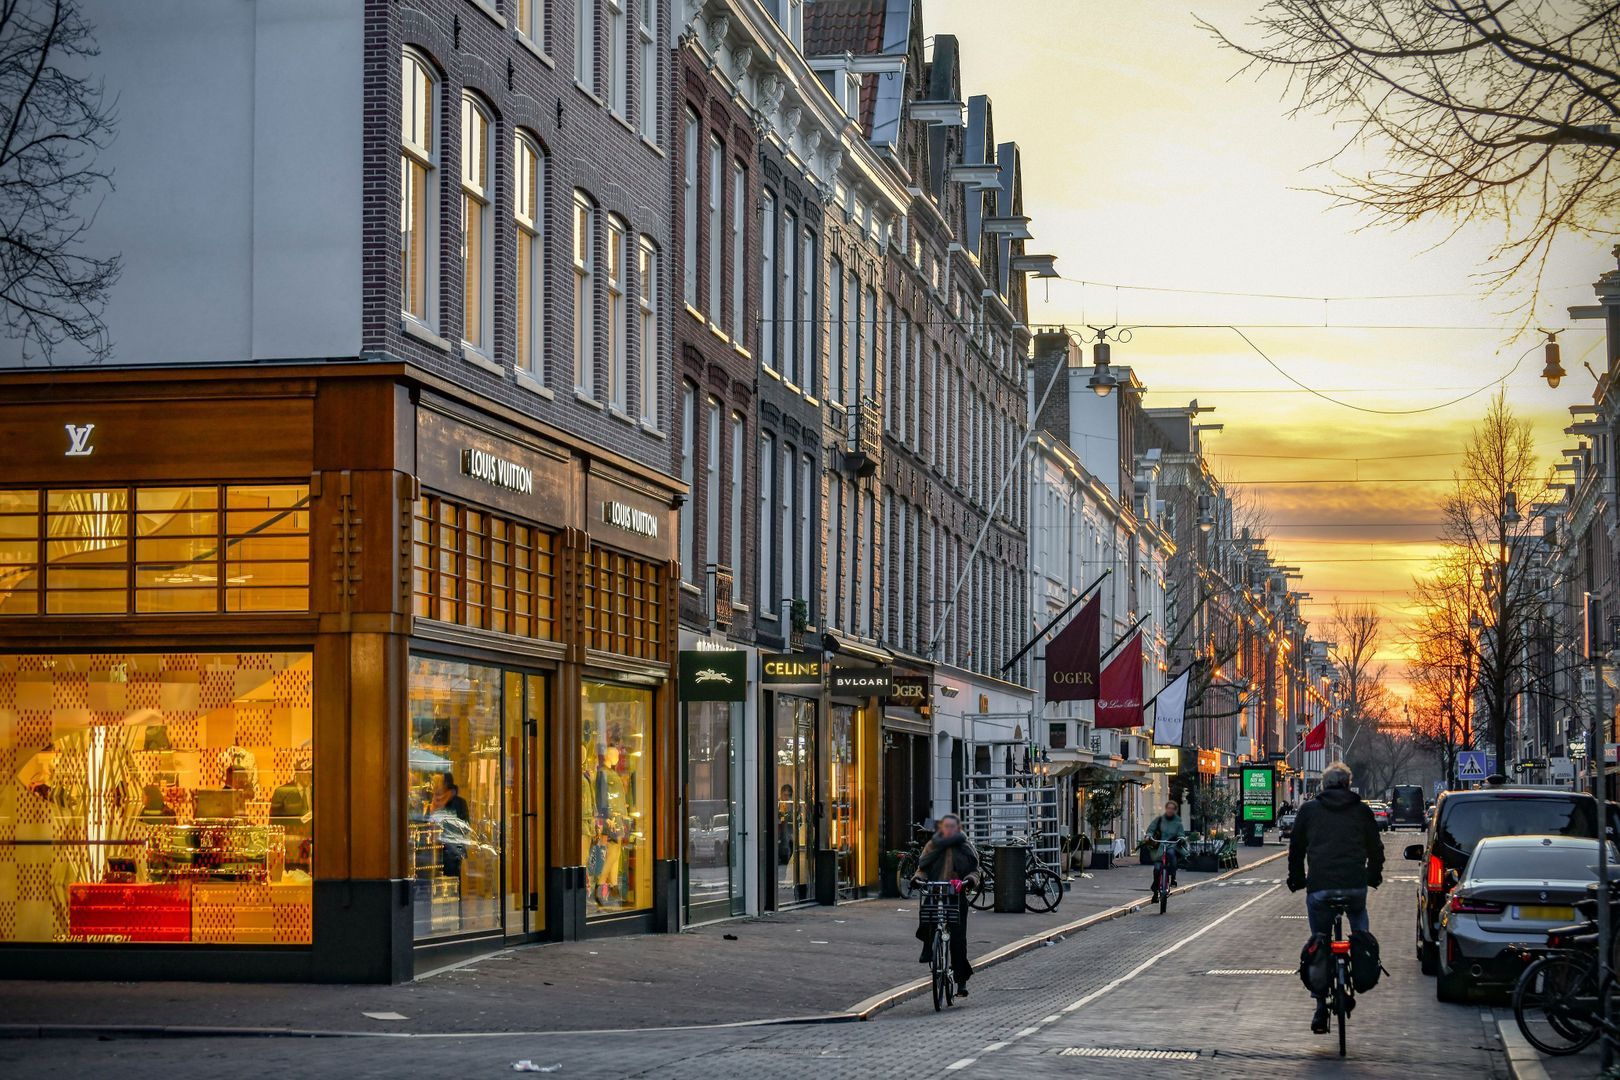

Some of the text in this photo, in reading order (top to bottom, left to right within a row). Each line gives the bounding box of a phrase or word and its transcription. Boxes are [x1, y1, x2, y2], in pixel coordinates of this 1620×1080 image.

[471, 449, 532, 495] LOUIS VUITTON
[611, 501, 658, 539] LOUIS VUITTON
[765, 661, 819, 676] CELINE
[837, 678, 888, 686] BVLGARI
[1053, 671, 1094, 685] OGER
[892, 683, 925, 699] OGER
[86, 934, 132, 942] VUITTON
